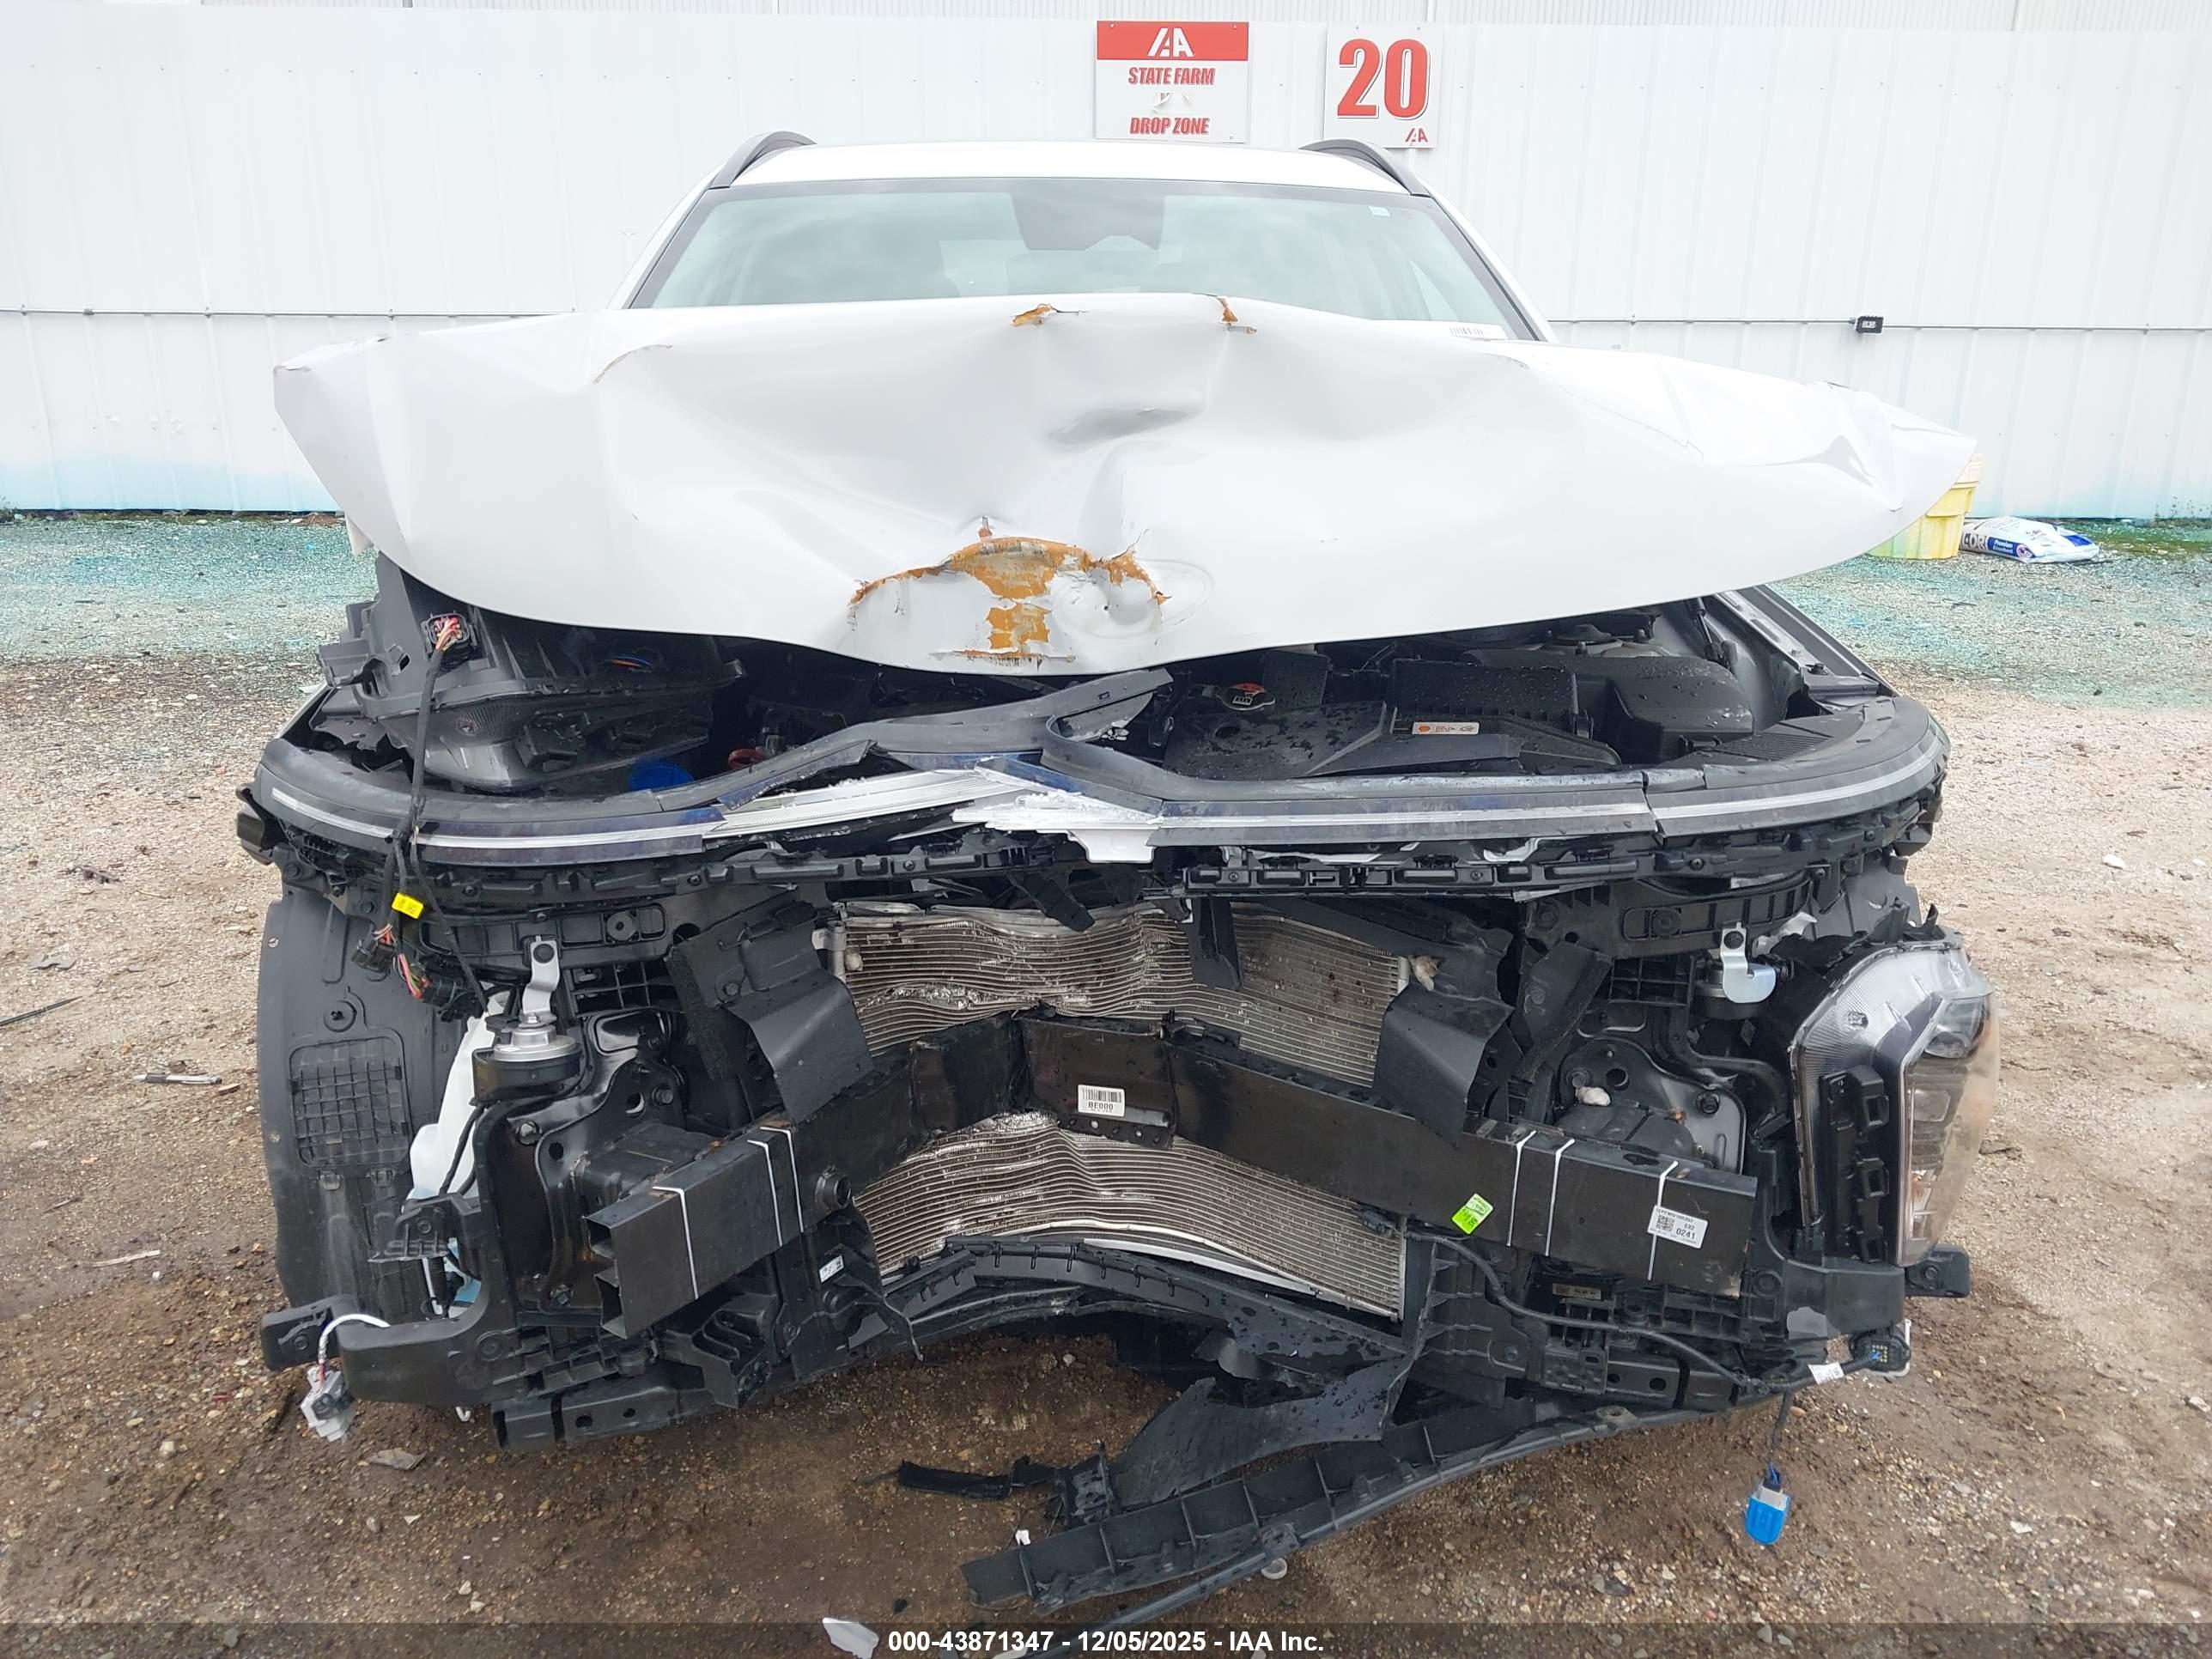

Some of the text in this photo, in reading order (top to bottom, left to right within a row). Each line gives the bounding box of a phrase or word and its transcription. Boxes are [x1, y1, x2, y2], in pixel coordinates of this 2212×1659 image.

[1128, 67, 1216, 86] STATE FARM
[1337, 39, 1431, 120] 20
[1130, 117, 1211, 136] DROP ZONE
